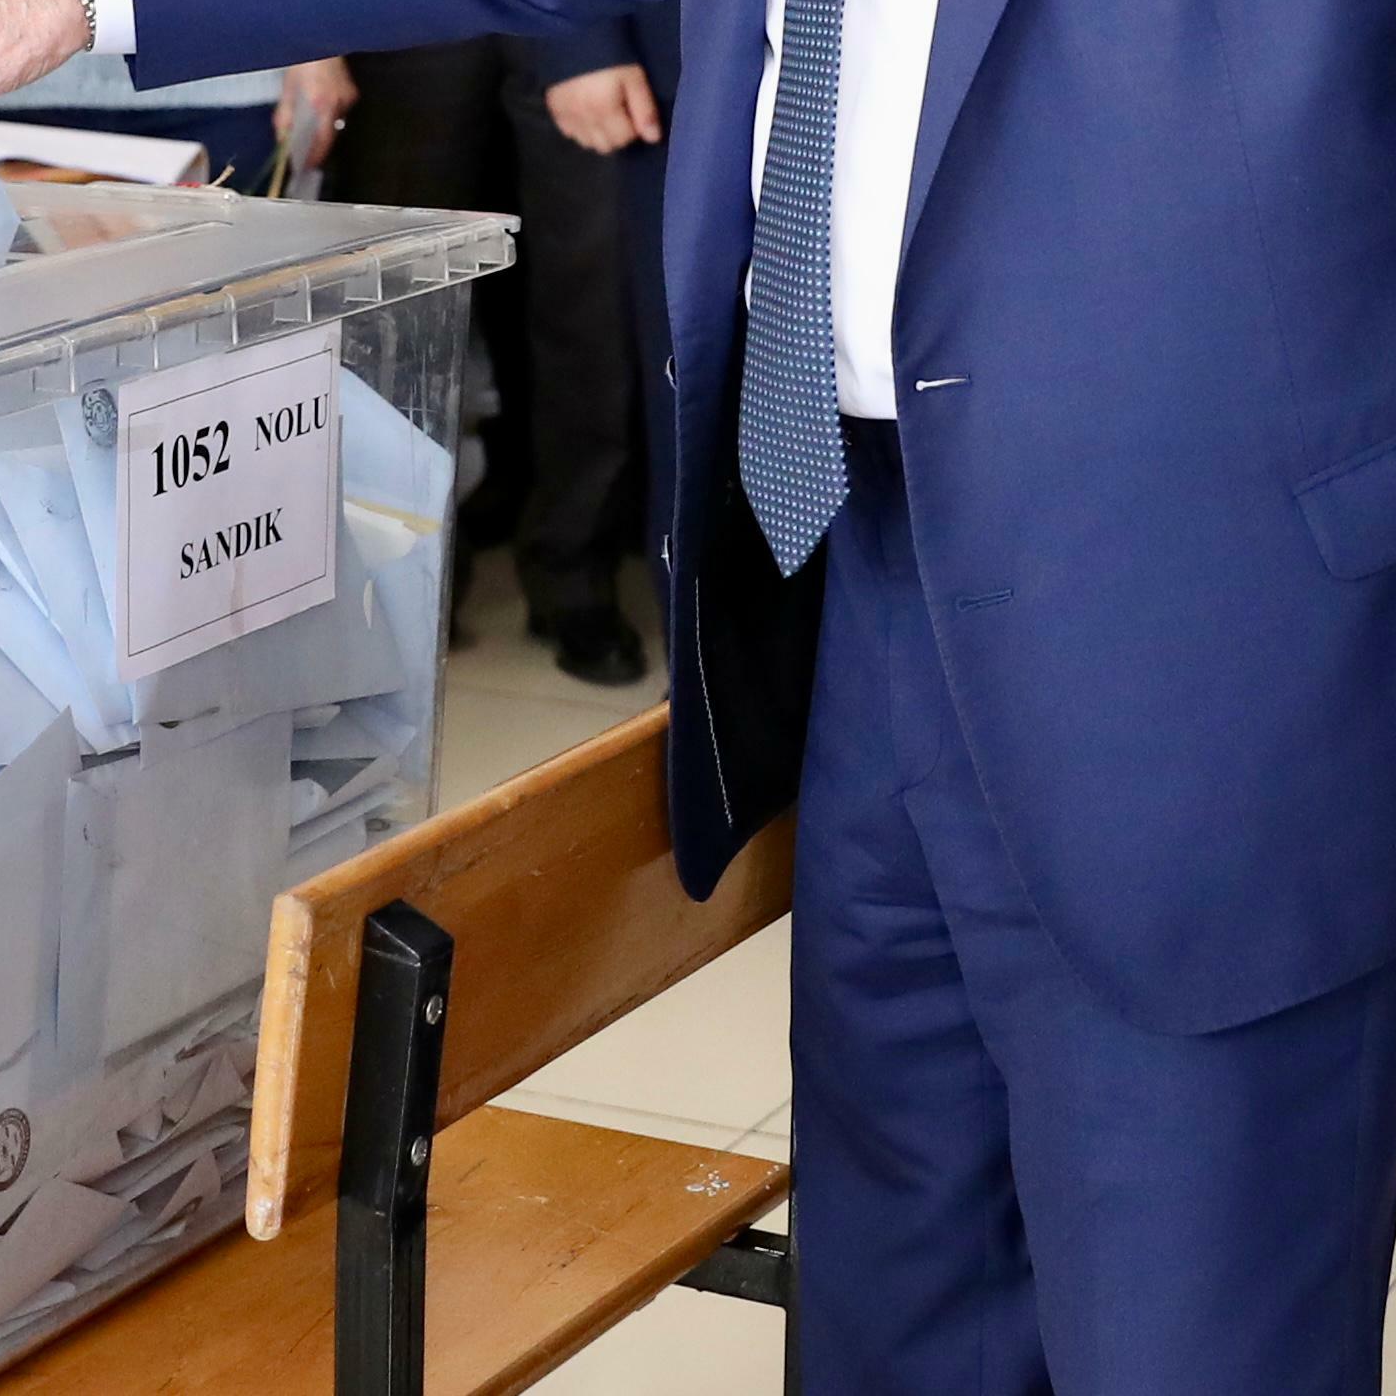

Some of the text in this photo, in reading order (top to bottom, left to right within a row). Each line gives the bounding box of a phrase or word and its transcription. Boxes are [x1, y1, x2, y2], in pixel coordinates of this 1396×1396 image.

[152, 394, 329, 497] 1052 NOLU
[180, 507, 283, 581] SANDIK
